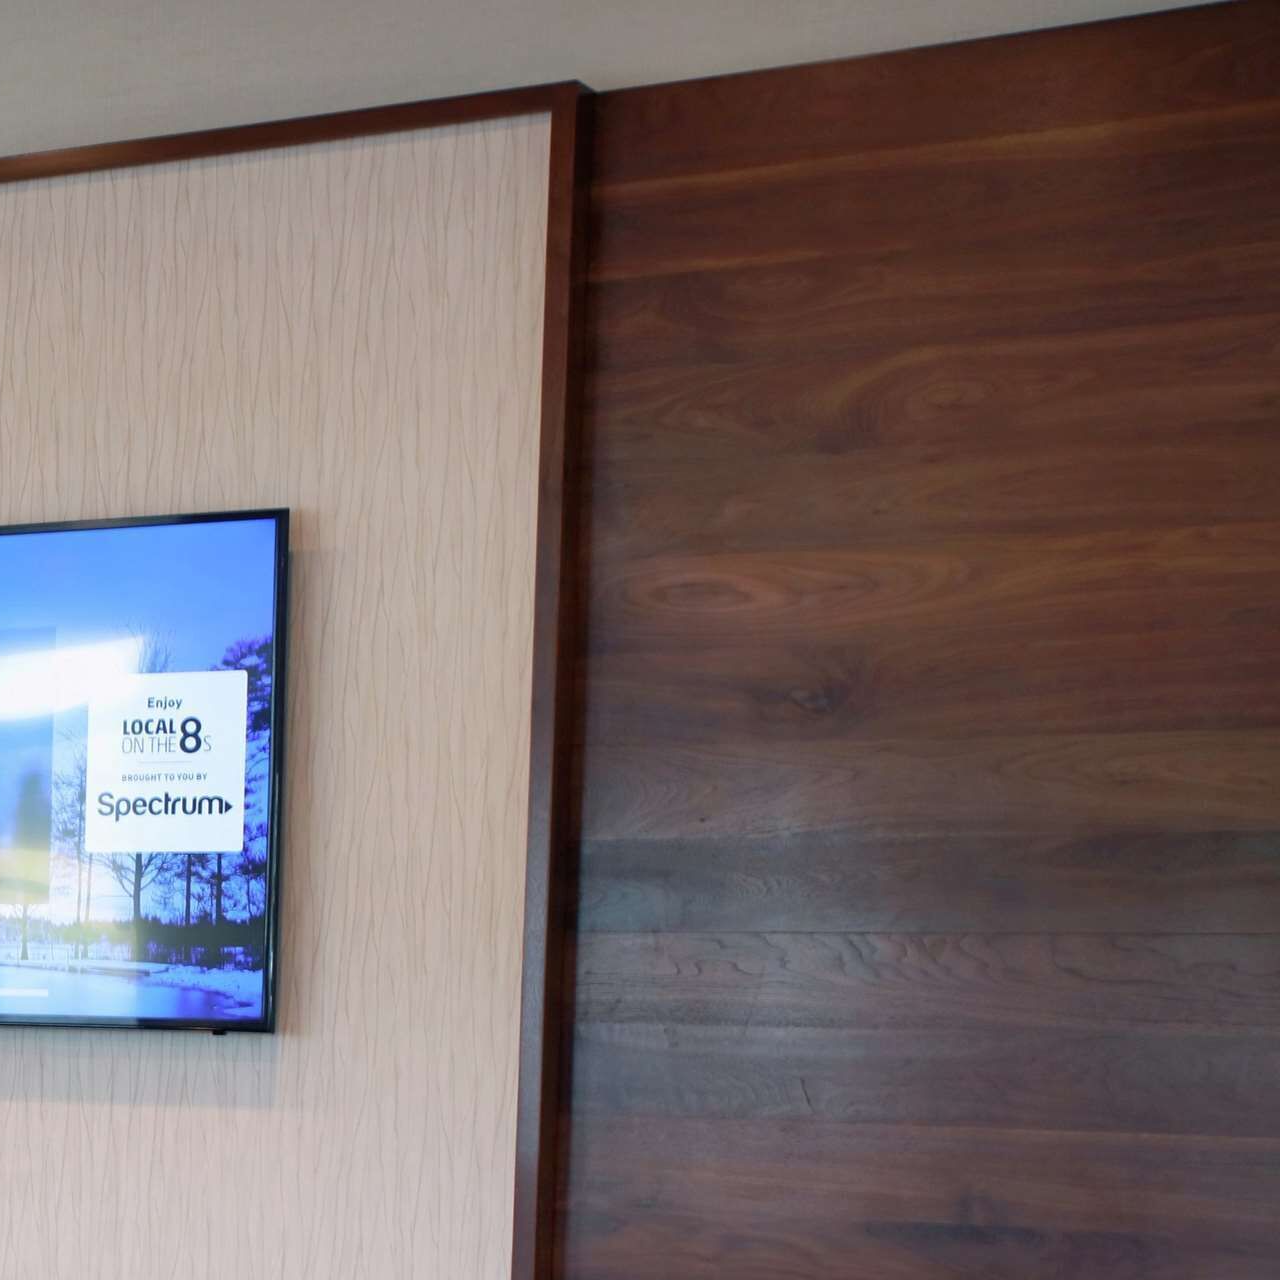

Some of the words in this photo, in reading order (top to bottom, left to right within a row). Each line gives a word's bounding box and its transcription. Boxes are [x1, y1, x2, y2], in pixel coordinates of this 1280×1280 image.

[147, 696, 182, 710] Enjoy
[123, 718, 176, 735] LOCAL
[122, 737, 144, 754] ON
[150, 736, 176, 753] THE
[122, 773, 161, 782] BROUGHT
[164, 773, 175, 781] TO
[177, 773, 194, 781] YOU
[196, 772, 208, 780] BY
[97, 792, 224, 823] Spectrum
